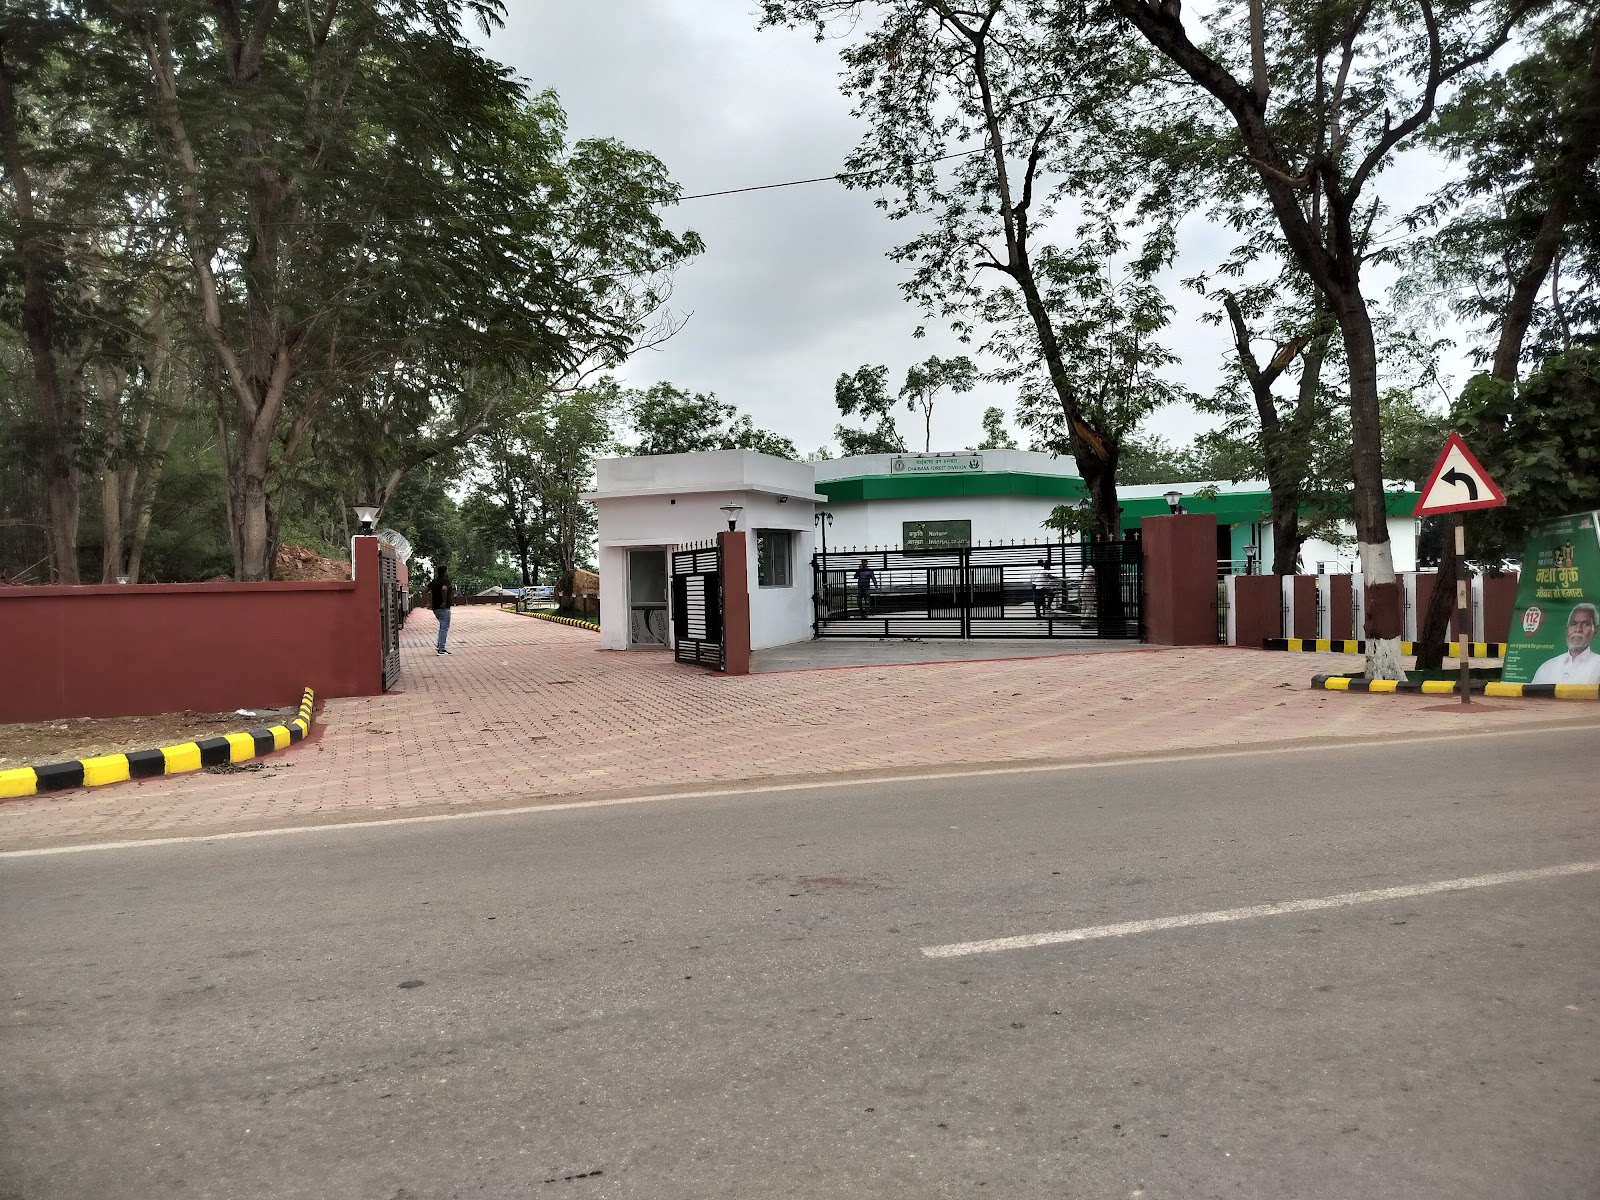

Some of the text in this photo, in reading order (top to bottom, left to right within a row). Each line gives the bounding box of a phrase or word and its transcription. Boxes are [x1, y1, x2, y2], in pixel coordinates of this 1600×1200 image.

[1535, 566, 1579, 588] नशा मुक्त
[1535, 585, 1584, 598] जीवन हो हमारा
[1525, 612, 1539, 623] 112
